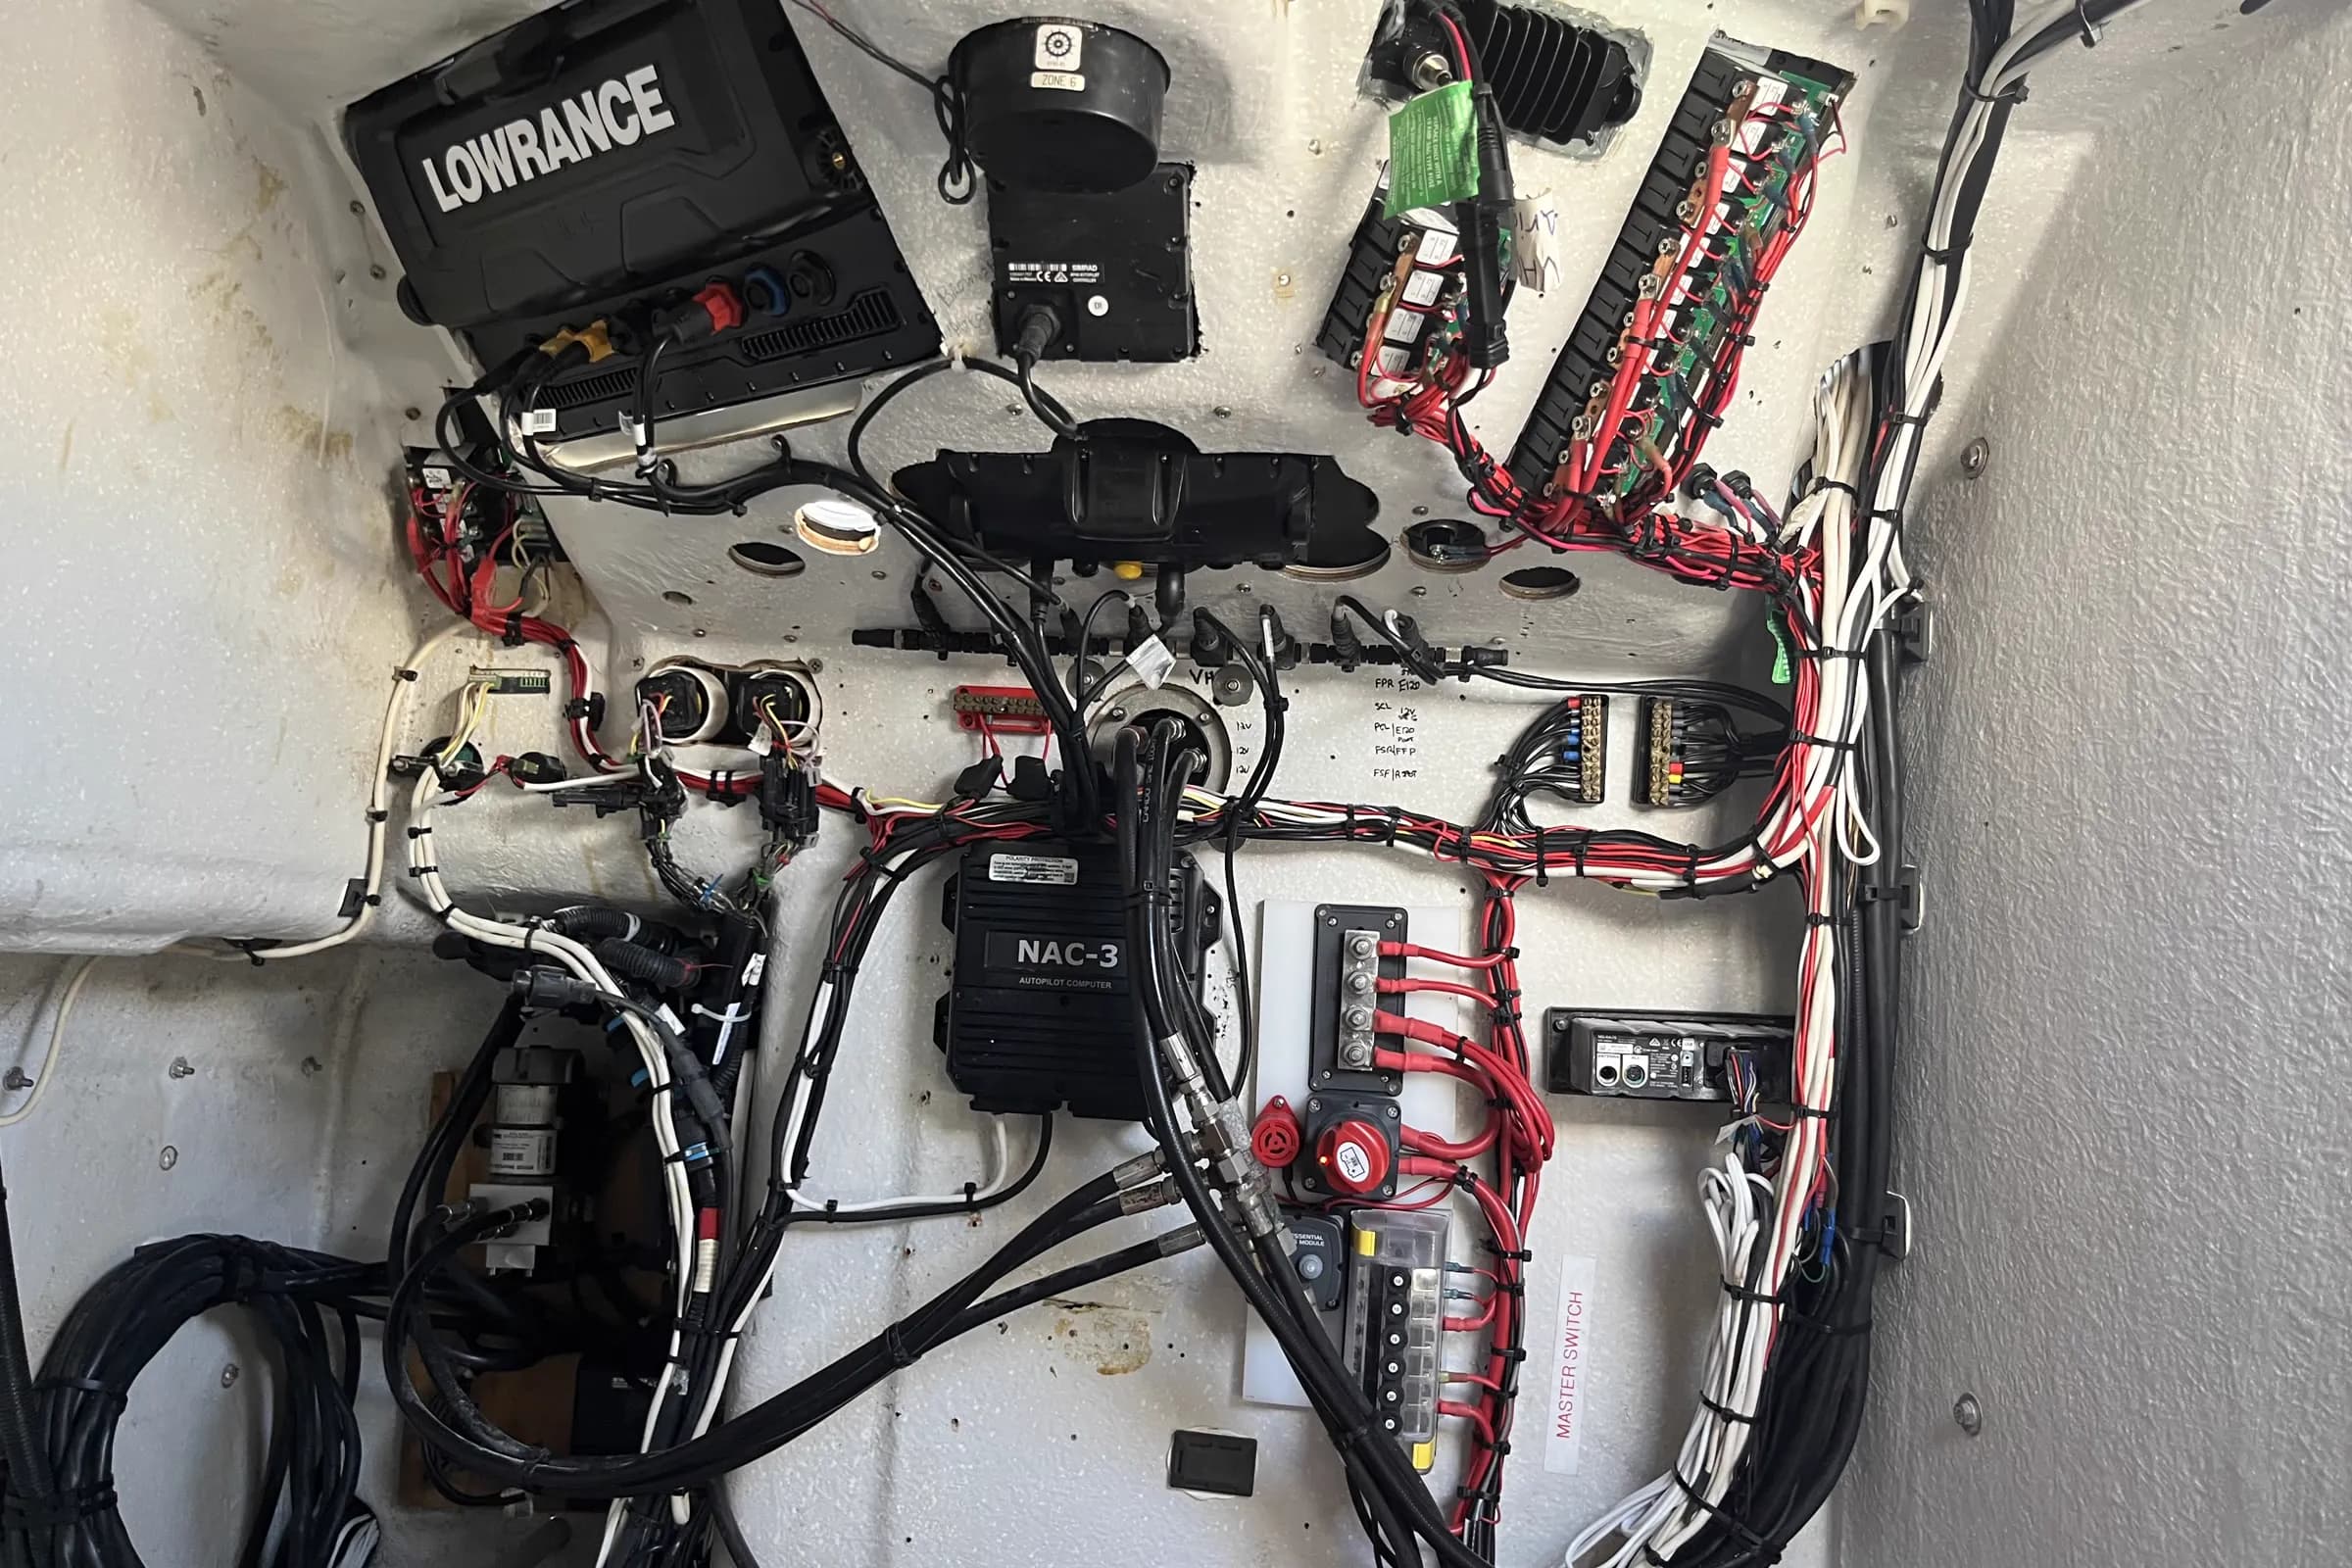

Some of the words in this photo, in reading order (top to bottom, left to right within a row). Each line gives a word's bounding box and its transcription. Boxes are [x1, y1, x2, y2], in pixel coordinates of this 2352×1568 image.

[1042, 74, 1067, 86] ZONE
[421, 64, 676, 213] LOWRANCE
[1018, 939, 1119, 968] NAC-3
[1019, 976, 1064, 987] AUTOPILOT
[1066, 979, 1112, 989] COMPUTER
[1563, 1291, 1584, 1361] SWITCH
[1555, 1364, 1577, 1440] MASTER
